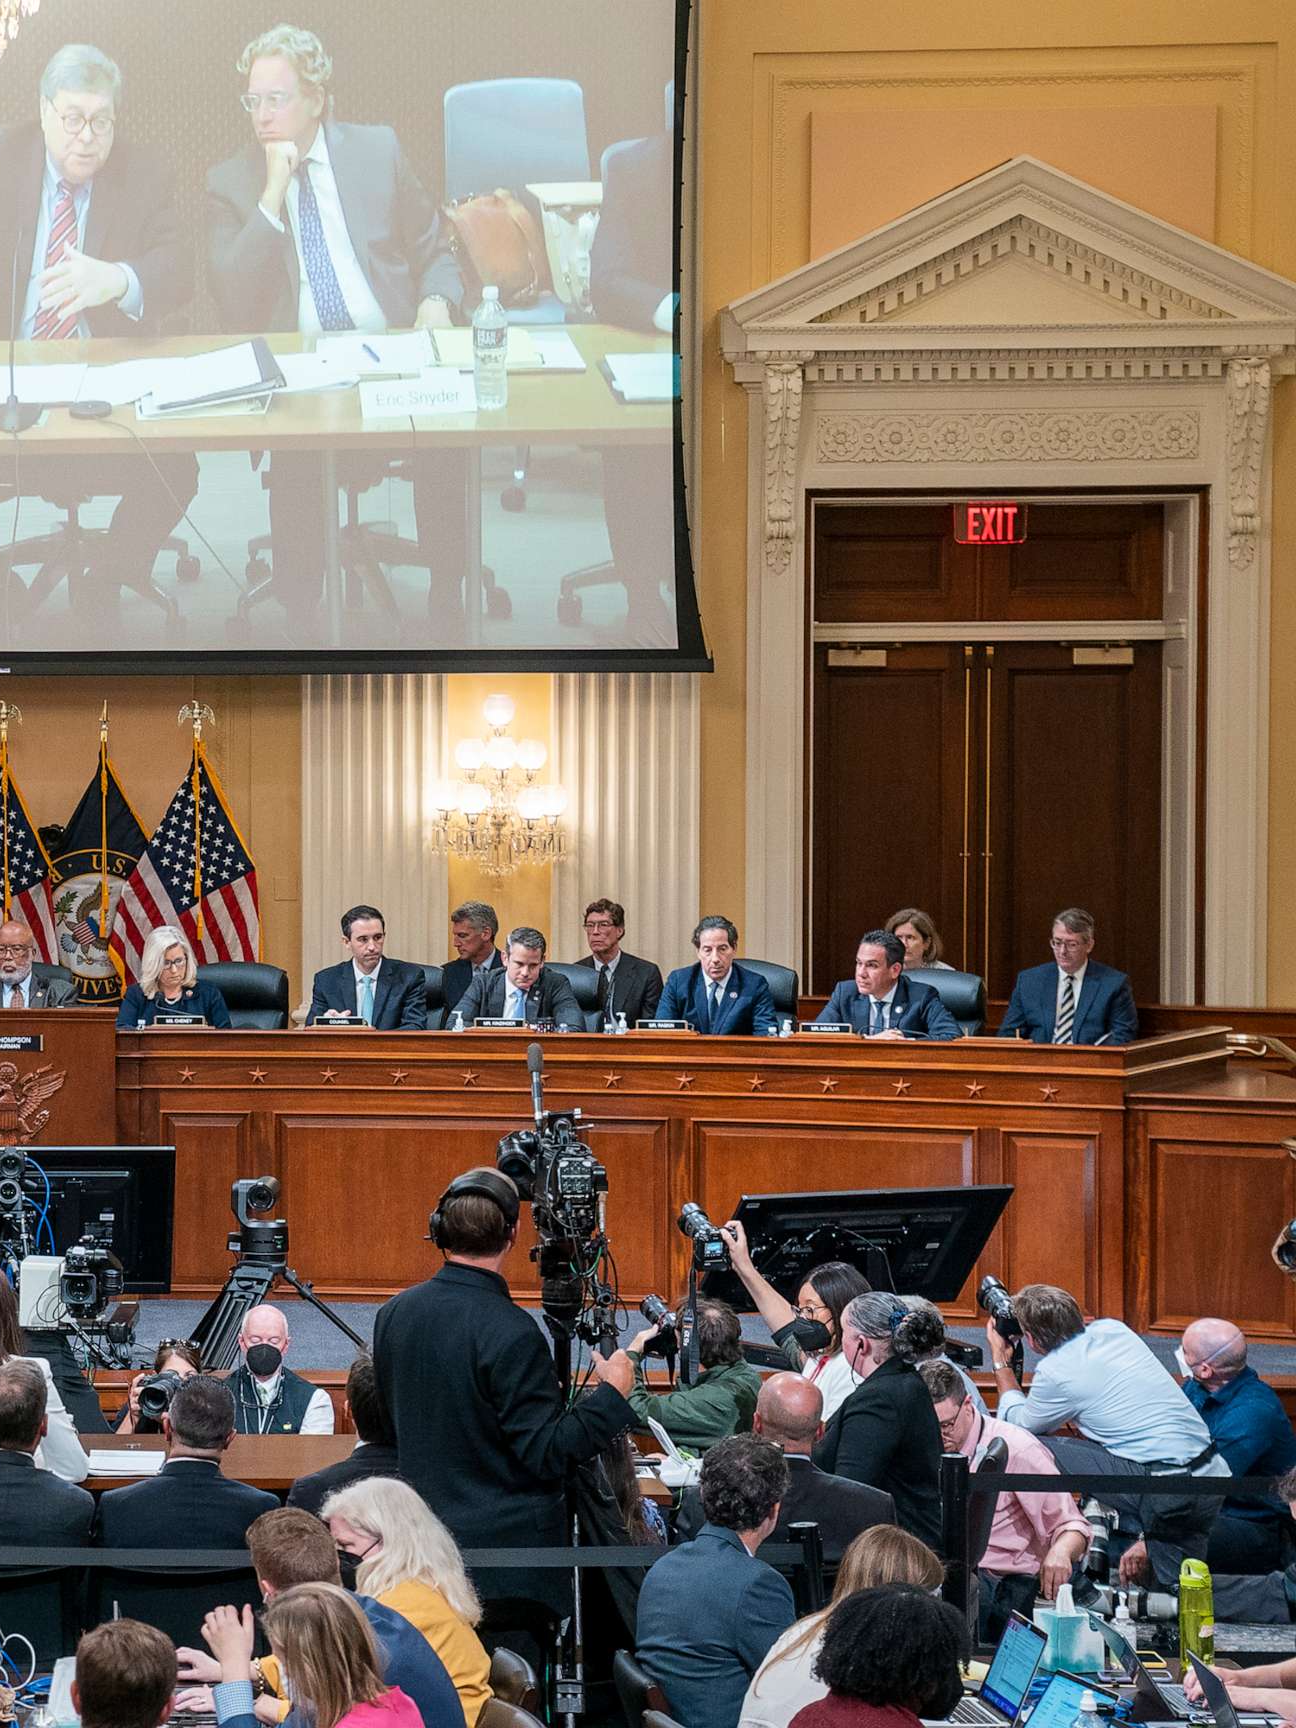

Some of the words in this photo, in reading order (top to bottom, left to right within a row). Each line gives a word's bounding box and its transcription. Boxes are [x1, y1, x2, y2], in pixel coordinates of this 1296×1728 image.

[375, 391, 403, 407] Eric
[407, 388, 460, 406] Snyder
[967, 507, 1018, 540] EXIT
